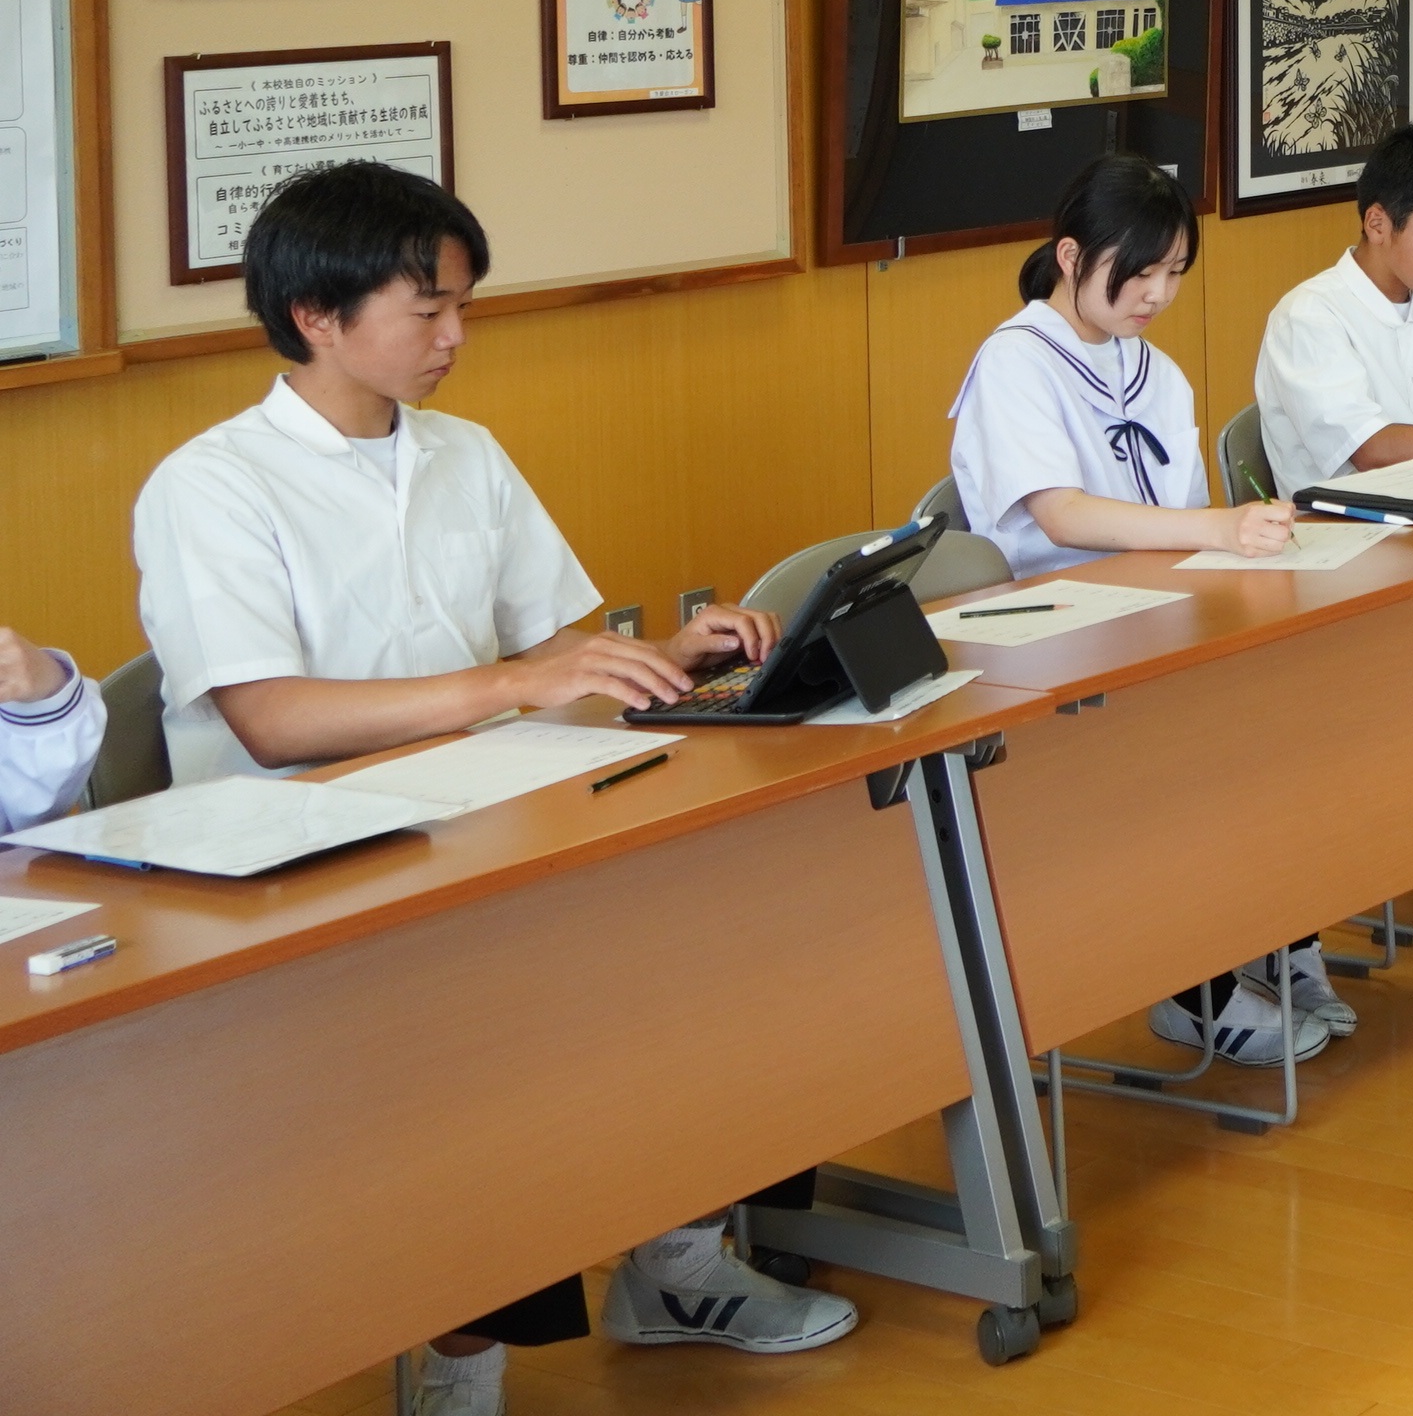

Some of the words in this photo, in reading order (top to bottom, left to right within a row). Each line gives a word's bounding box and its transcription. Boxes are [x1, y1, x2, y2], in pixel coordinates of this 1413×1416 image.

[588, 28, 675, 42] 自律：自分から考動
[568, 49, 693, 65] 尊重：仲間を認める・応える
[199, 91, 355, 116] ふるさとへの誇りと愛着をもち、
[209, 104, 428, 136] 自立してふるさとや地域に貢献する生徒の育成
